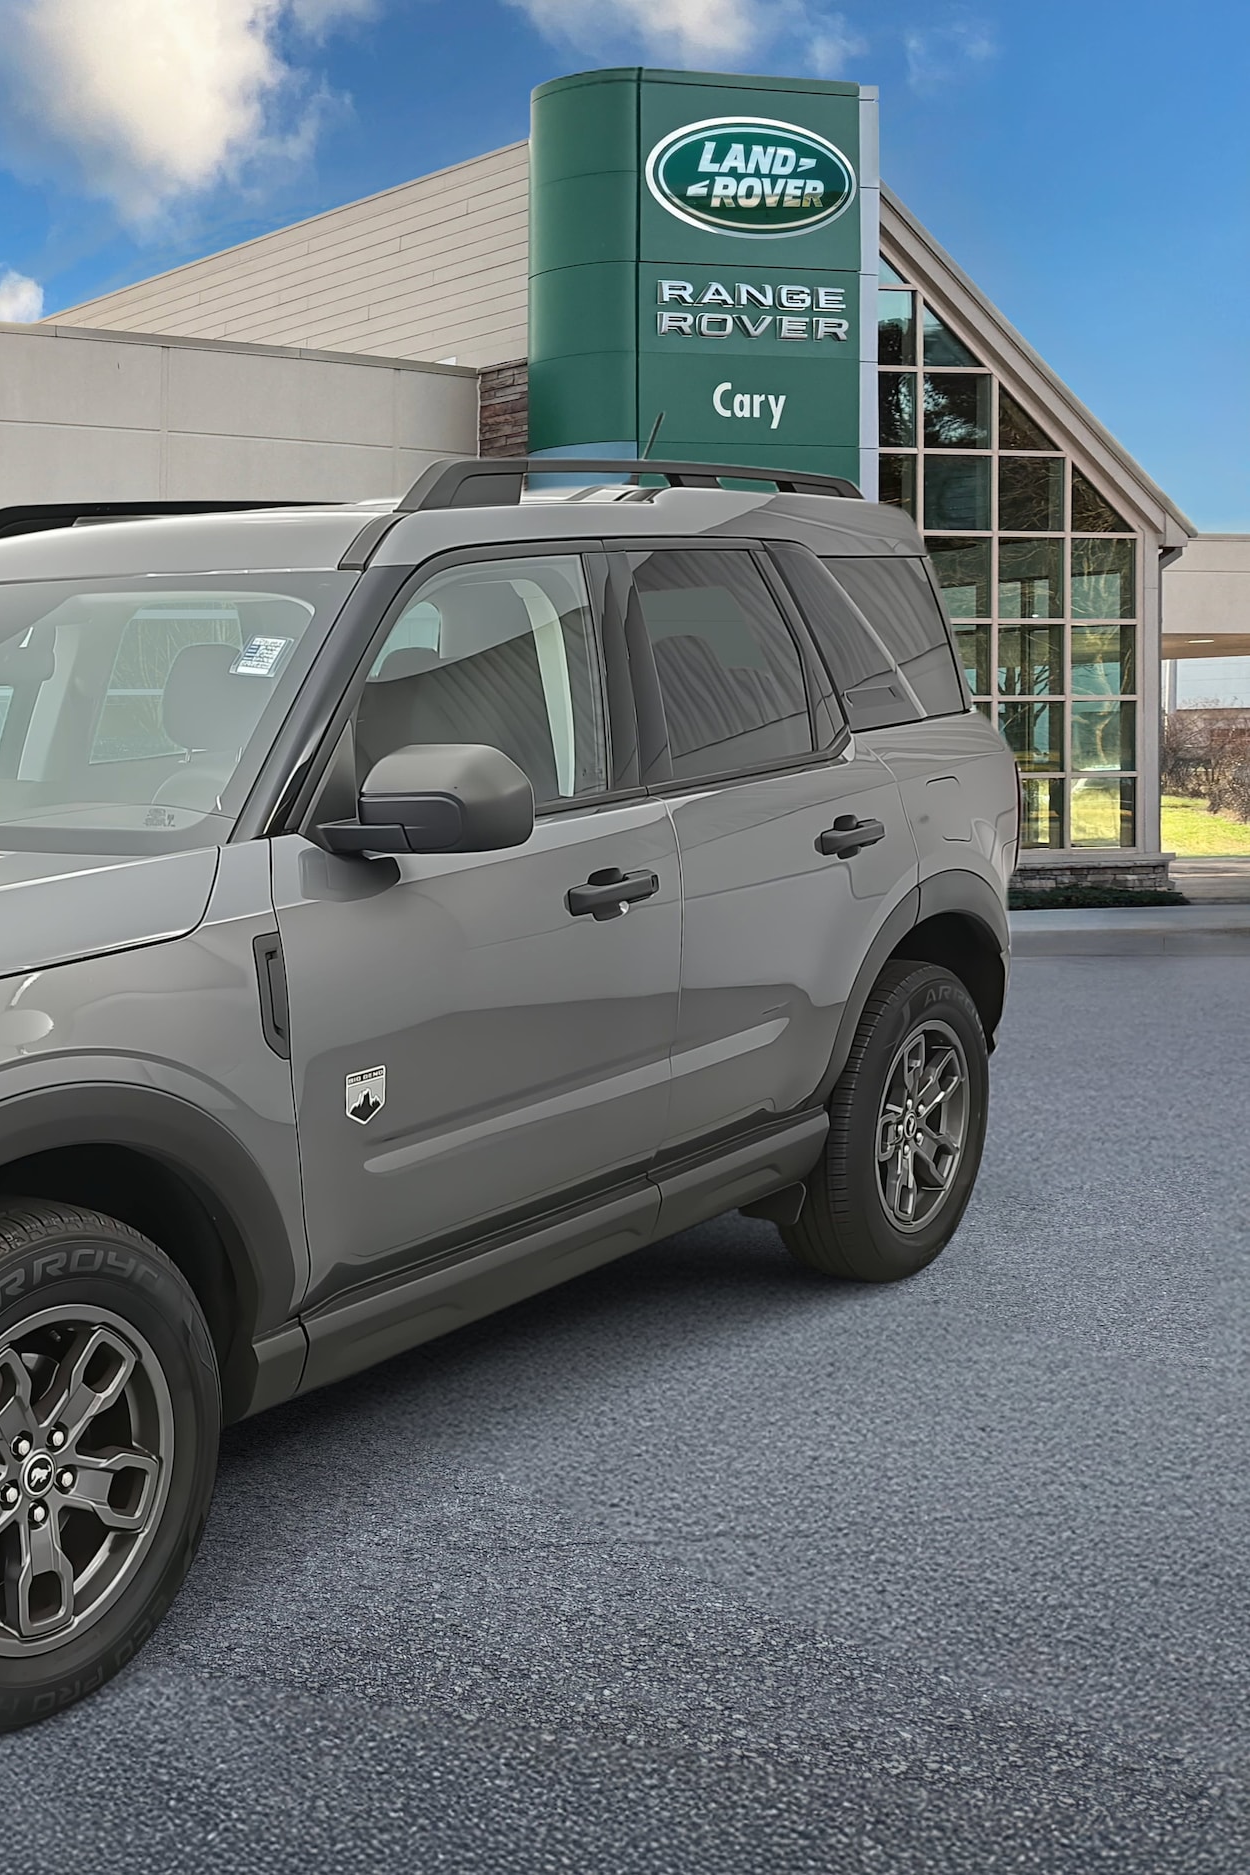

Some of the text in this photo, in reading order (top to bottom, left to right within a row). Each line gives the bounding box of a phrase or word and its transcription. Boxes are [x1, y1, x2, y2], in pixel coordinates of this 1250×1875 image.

[697, 140, 797, 176] LAND
[709, 176, 825, 209] ROVER
[656, 279, 847, 312] RANGE
[656, 310, 849, 342] ROVER
[712, 381, 787, 430] Cary
